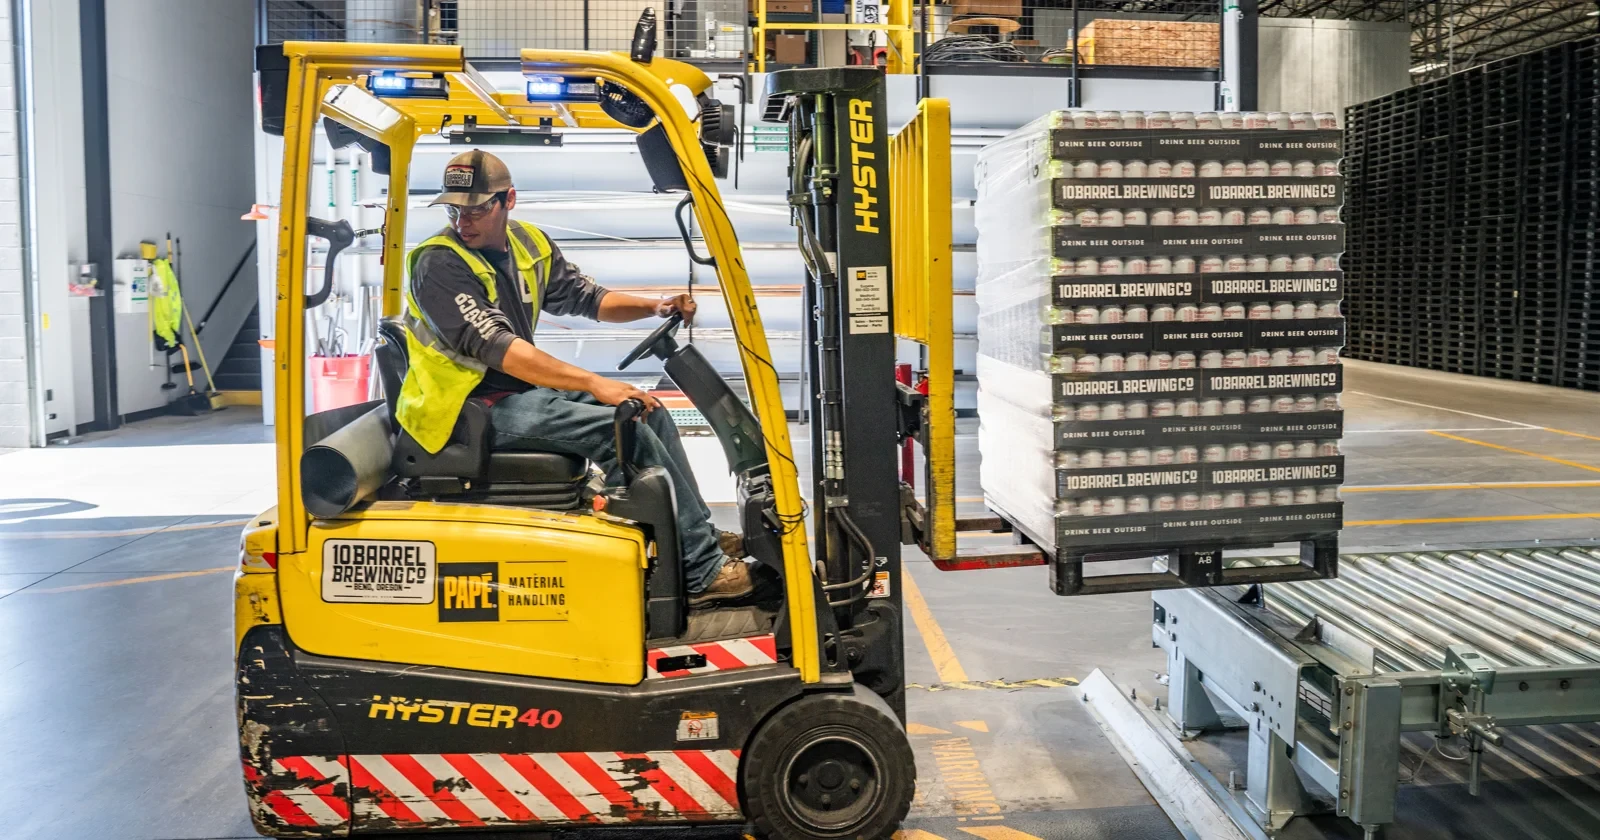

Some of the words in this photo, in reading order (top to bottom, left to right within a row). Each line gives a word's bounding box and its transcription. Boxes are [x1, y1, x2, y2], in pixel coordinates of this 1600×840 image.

[849, 98, 880, 234] HYSTER
[1211, 331, 1243, 339] OUTSIDE
[1306, 423, 1337, 431] OUTSIDE
[1062, 431, 1089, 439] DRINK
[1112, 429, 1145, 437] OUTSIDE
[1210, 518, 1242, 526] OUTSIDE
[1259, 515, 1283, 523] DRINK
[1305, 512, 1336, 520] OUTSIDE
[1064, 528, 1090, 536] DRINK
[509, 577, 564, 588] MATERIAL
[508, 594, 565, 606] HANDLING
[368, 695, 518, 729] HYSTER
[518, 708, 563, 729] 40
